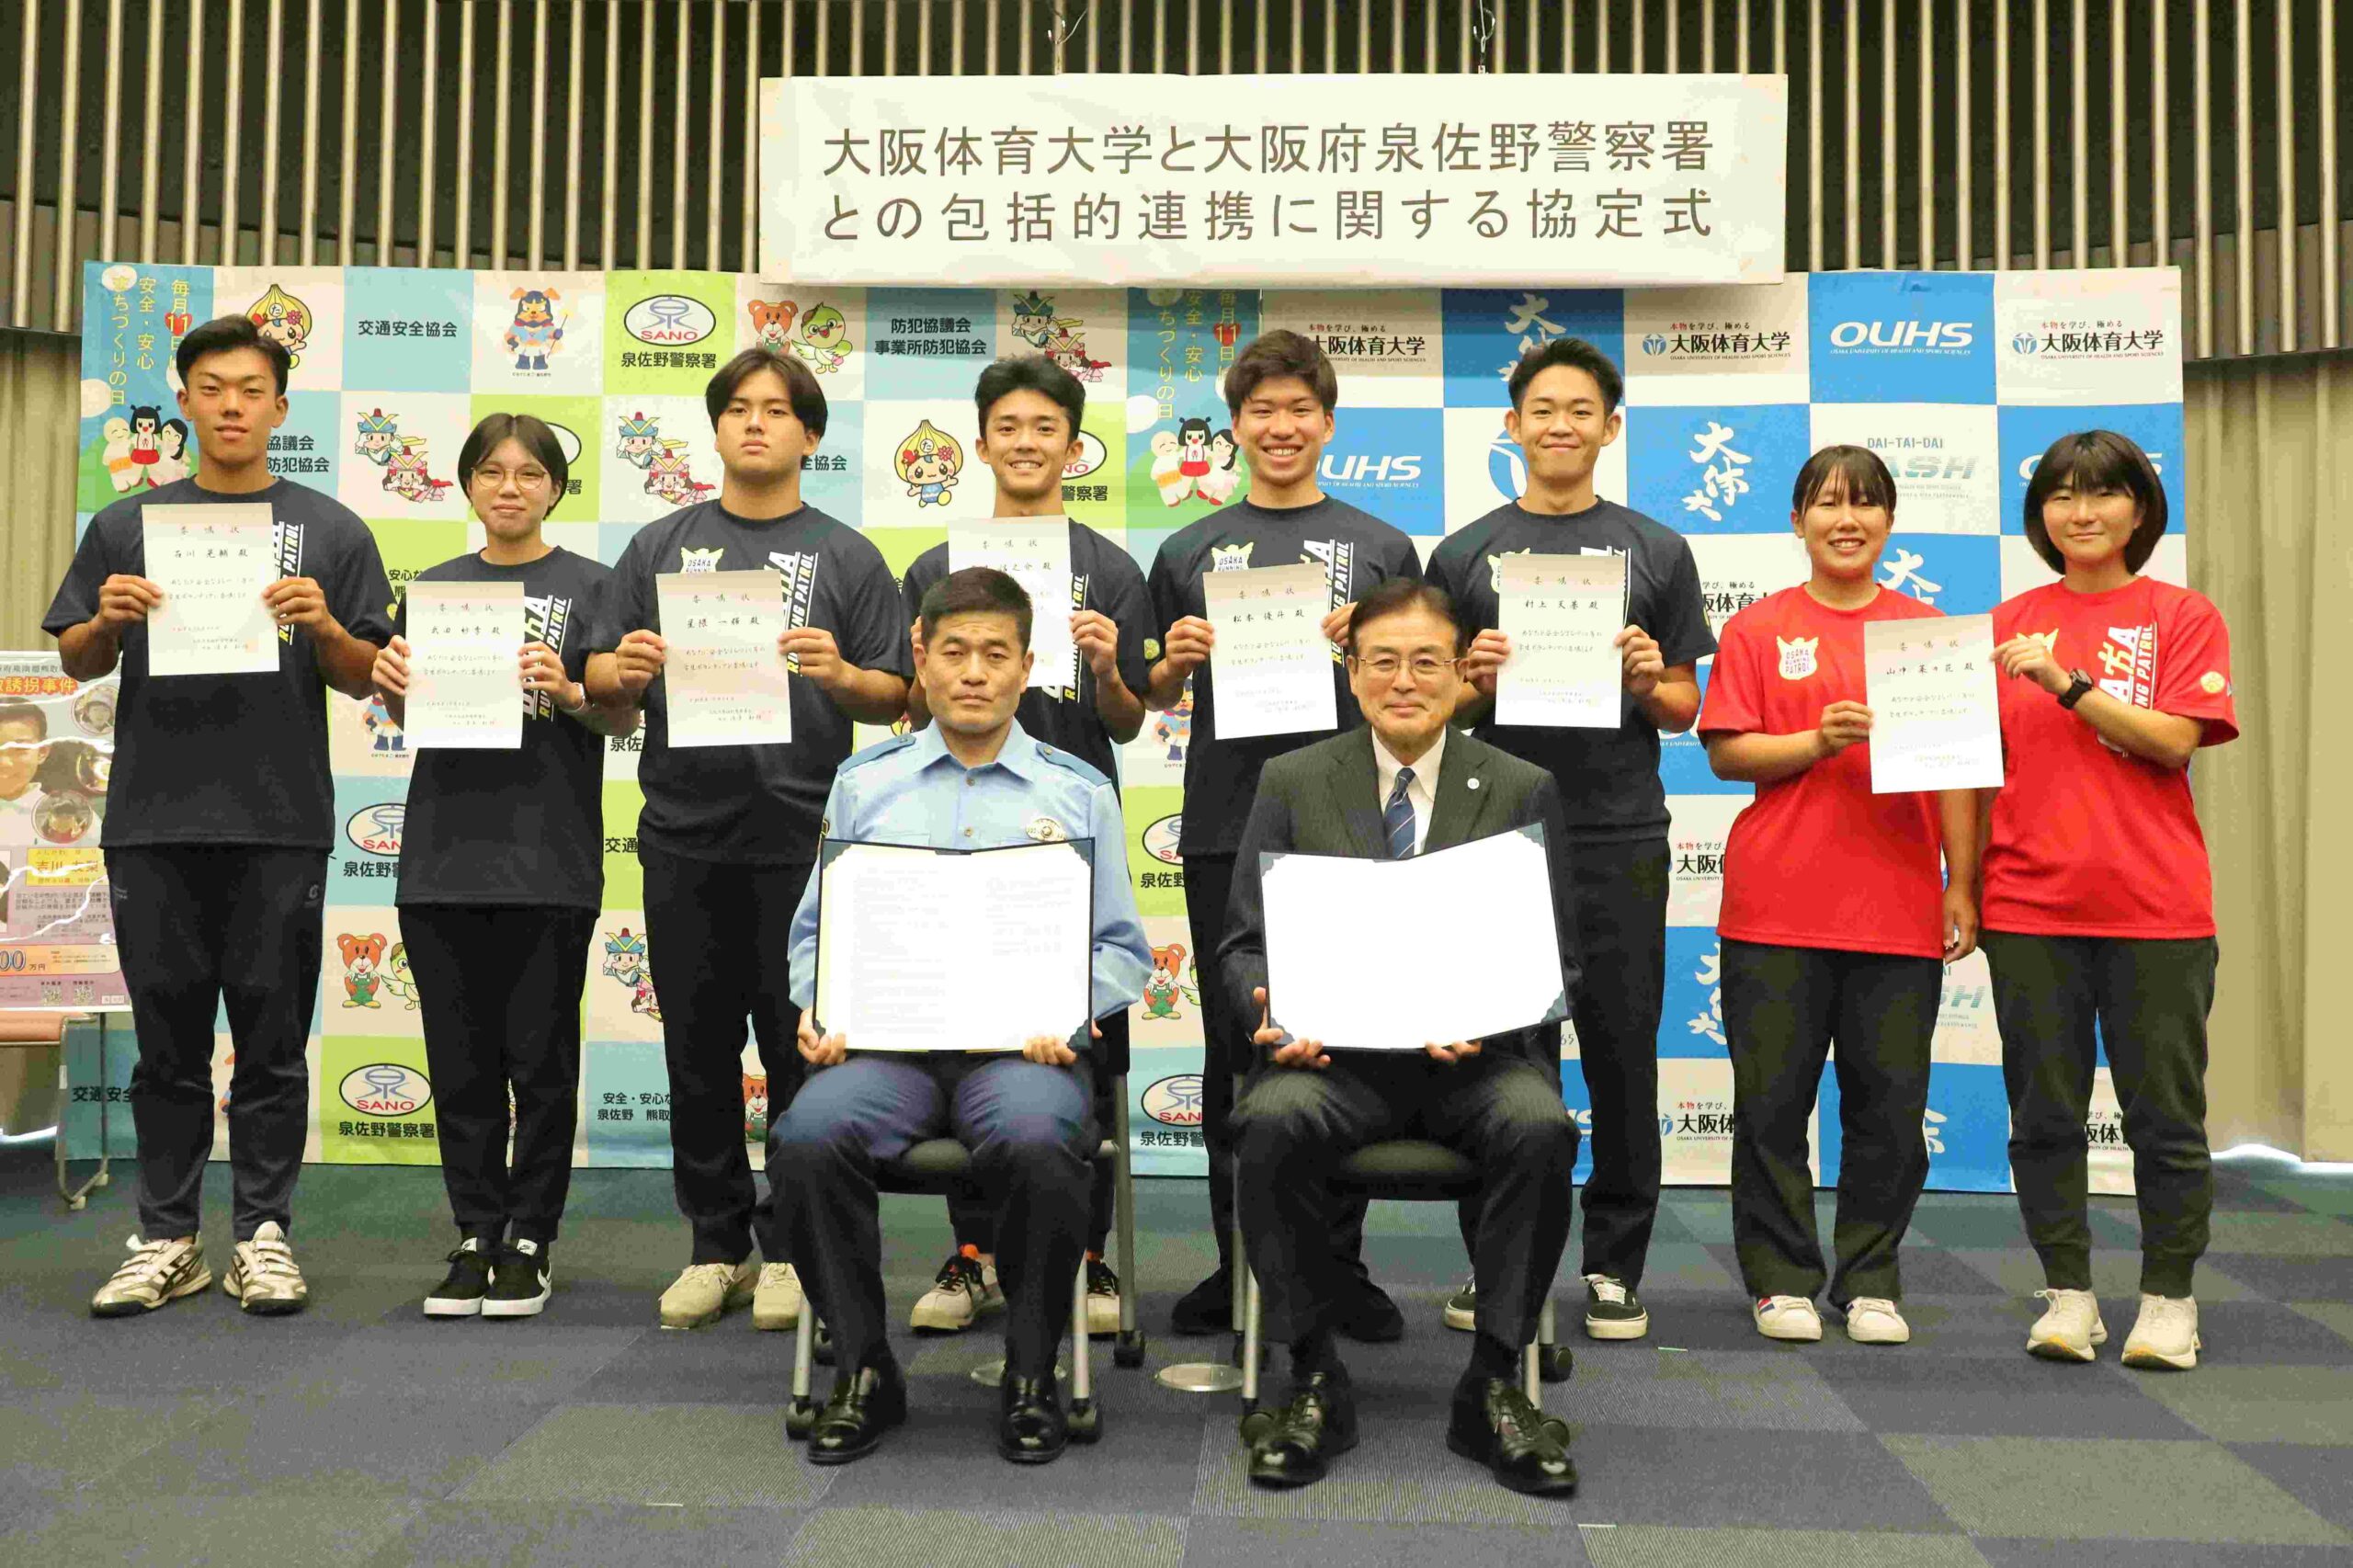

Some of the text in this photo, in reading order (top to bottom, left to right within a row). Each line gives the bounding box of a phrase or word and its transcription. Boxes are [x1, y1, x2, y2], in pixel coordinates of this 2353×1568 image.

[824, 121, 1712, 176] 大阪体育大学と大阪府泉佐野警察署
[825, 188, 1711, 242] との包括的連携に関する協定式
[136, 278, 156, 369] 安全・安心
[358, 320, 458, 338] 交通安全協会
[891, 317, 972, 334] 防犯協議会
[1830, 321, 1972, 347] OUHS
[640, 330, 699, 342] SANO
[874, 338, 987, 356] 事業所防犯協会
[1314, 335, 1426, 356] 大阪体育大学
[1670, 332, 1790, 353] 大阪体育大学
[2041, 330, 2164, 353] 大阪体育大学
[620, 351, 717, 369] 泉佐野警察署
[1868, 437, 1943, 449] DAI-TAI-DAI
[267, 457, 329, 472] 防犯協会
[1063, 464, 1088, 473] NO
[1316, 454, 1422, 481] UHS
[1884, 456, 1979, 479] ASH
[1062, 485, 1108, 501] 警察署
[283, 524, 300, 573] PATROL
[795, 553, 814, 603] PATROL
[1335, 542, 1348, 593] PATROL
[1073, 575, 1085, 608] TROL
[546, 597, 568, 649] PATROL
[2136, 623, 2153, 680] PATROL
[357, 1099, 415, 1111] SANO
[338, 1122, 435, 1139] 泉佐野警察署
